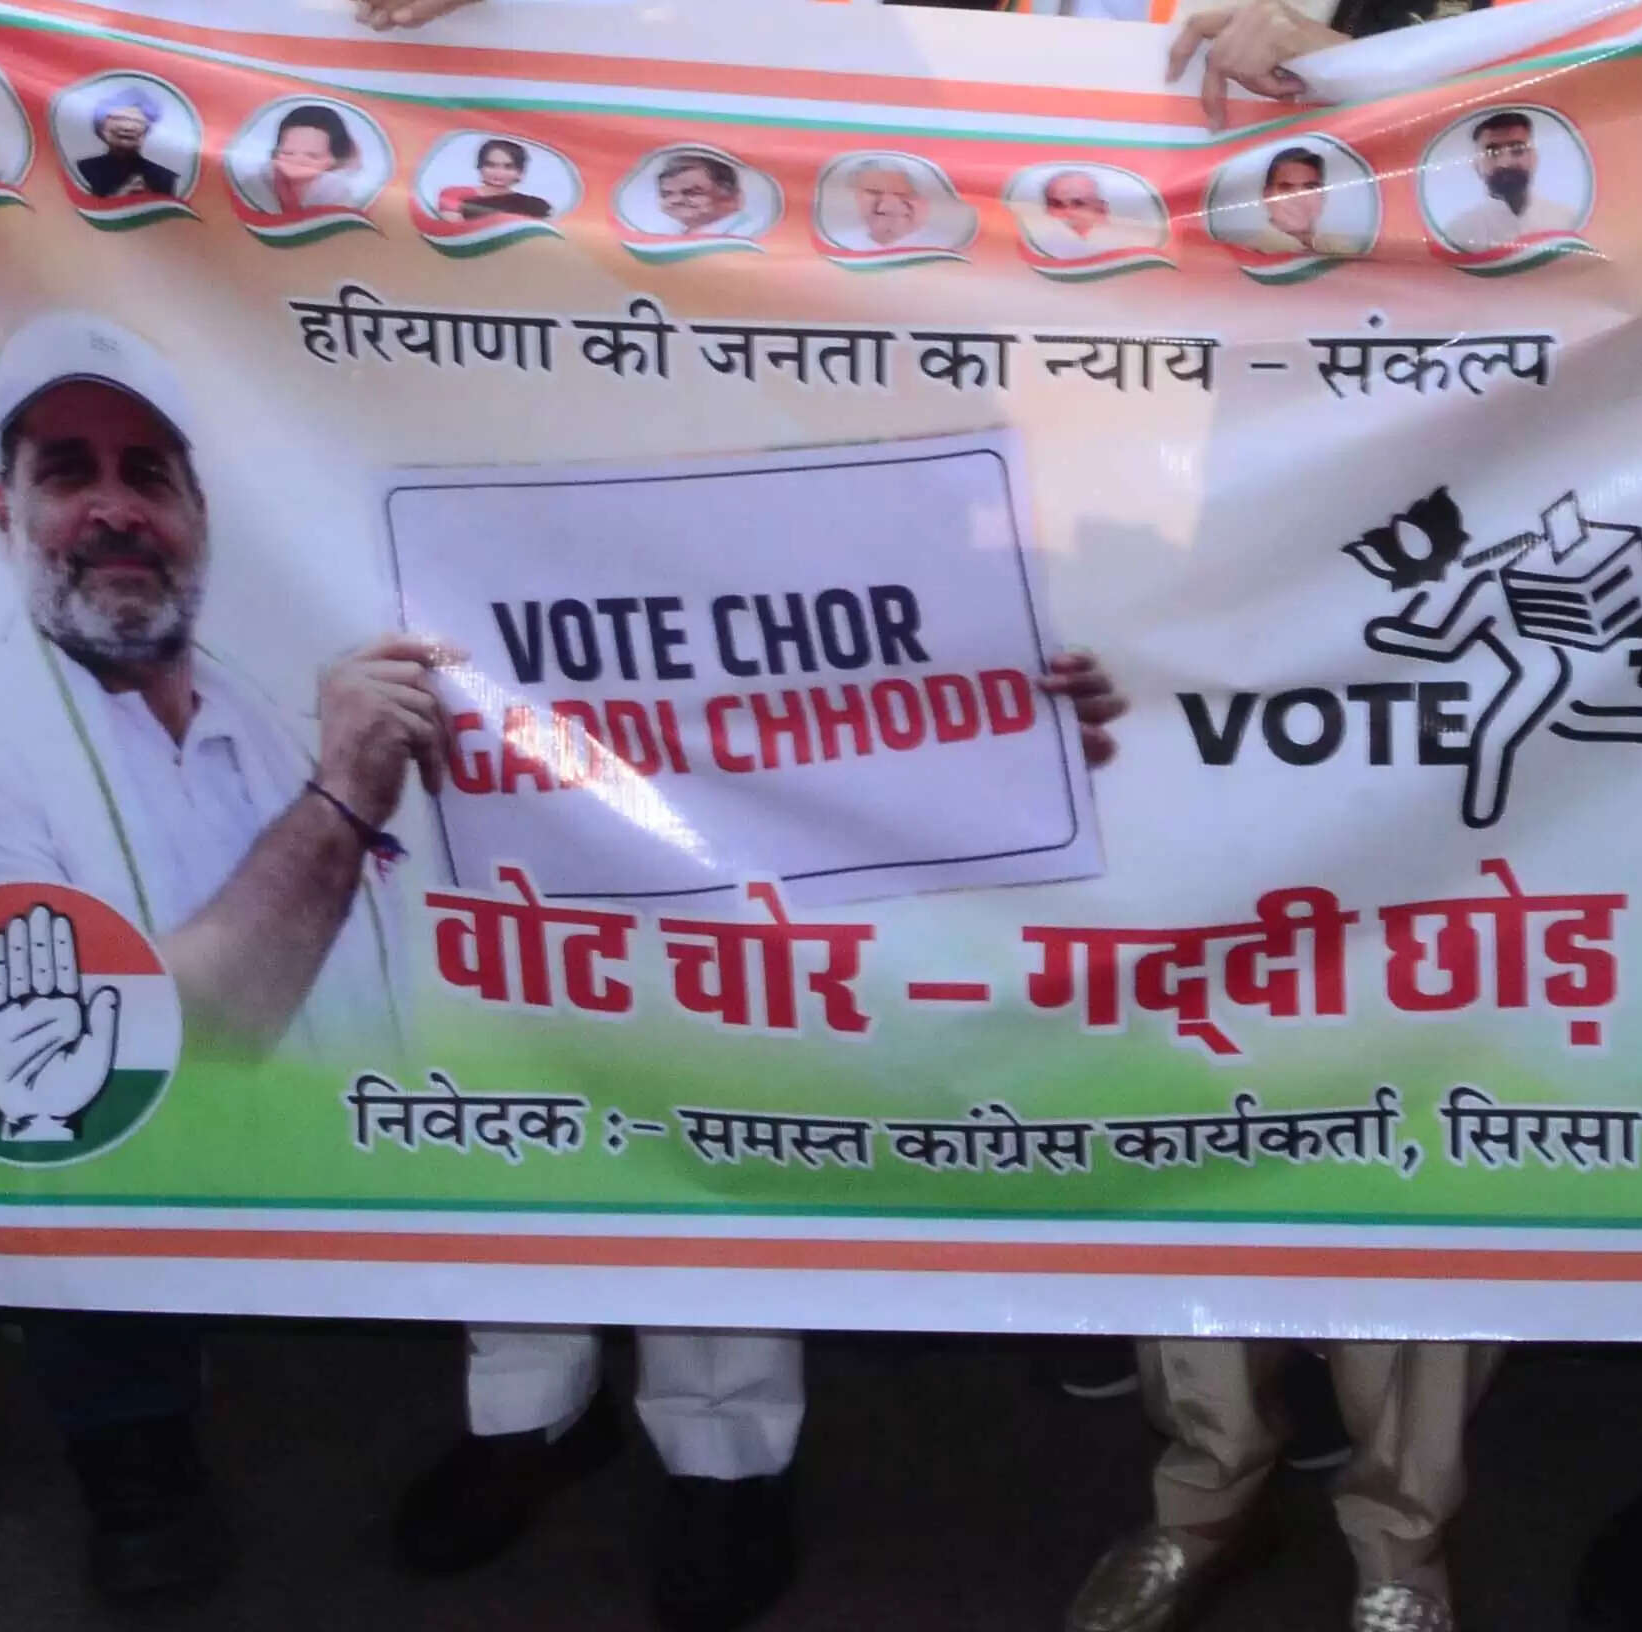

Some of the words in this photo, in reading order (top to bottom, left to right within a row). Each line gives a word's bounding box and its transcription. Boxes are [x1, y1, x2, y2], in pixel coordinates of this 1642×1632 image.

[289, 285, 559, 371] हरियाणा
[571, 298, 678, 377] की
[689, 324, 896, 385] जनता
[910, 331, 1017, 389] का
[1033, 334, 1221, 391] न्याय
[1308, 315, 1555, 395] संकल्प
[491, 596, 695, 684] VOTE
[711, 584, 932, 676] CHOR
[448, 699, 692, 795] GADDI
[706, 667, 1037, 774] CHHODD
[1176, 680, 1473, 768] VOTE
[424, 866, 636, 1013] वोट
[659, 881, 876, 1032] चोर
[1022, 886, 1360, 1055] गद्दी
[1378, 857, 1627, 1046] छोड़
[347, 1071, 585, 1158] निवेदक
[678, 1110, 872, 1173] समस्त
[887, 1103, 1095, 1172] कांग्रेस
[1107, 1086, 1418, 1175] कार्यकर्ता,
